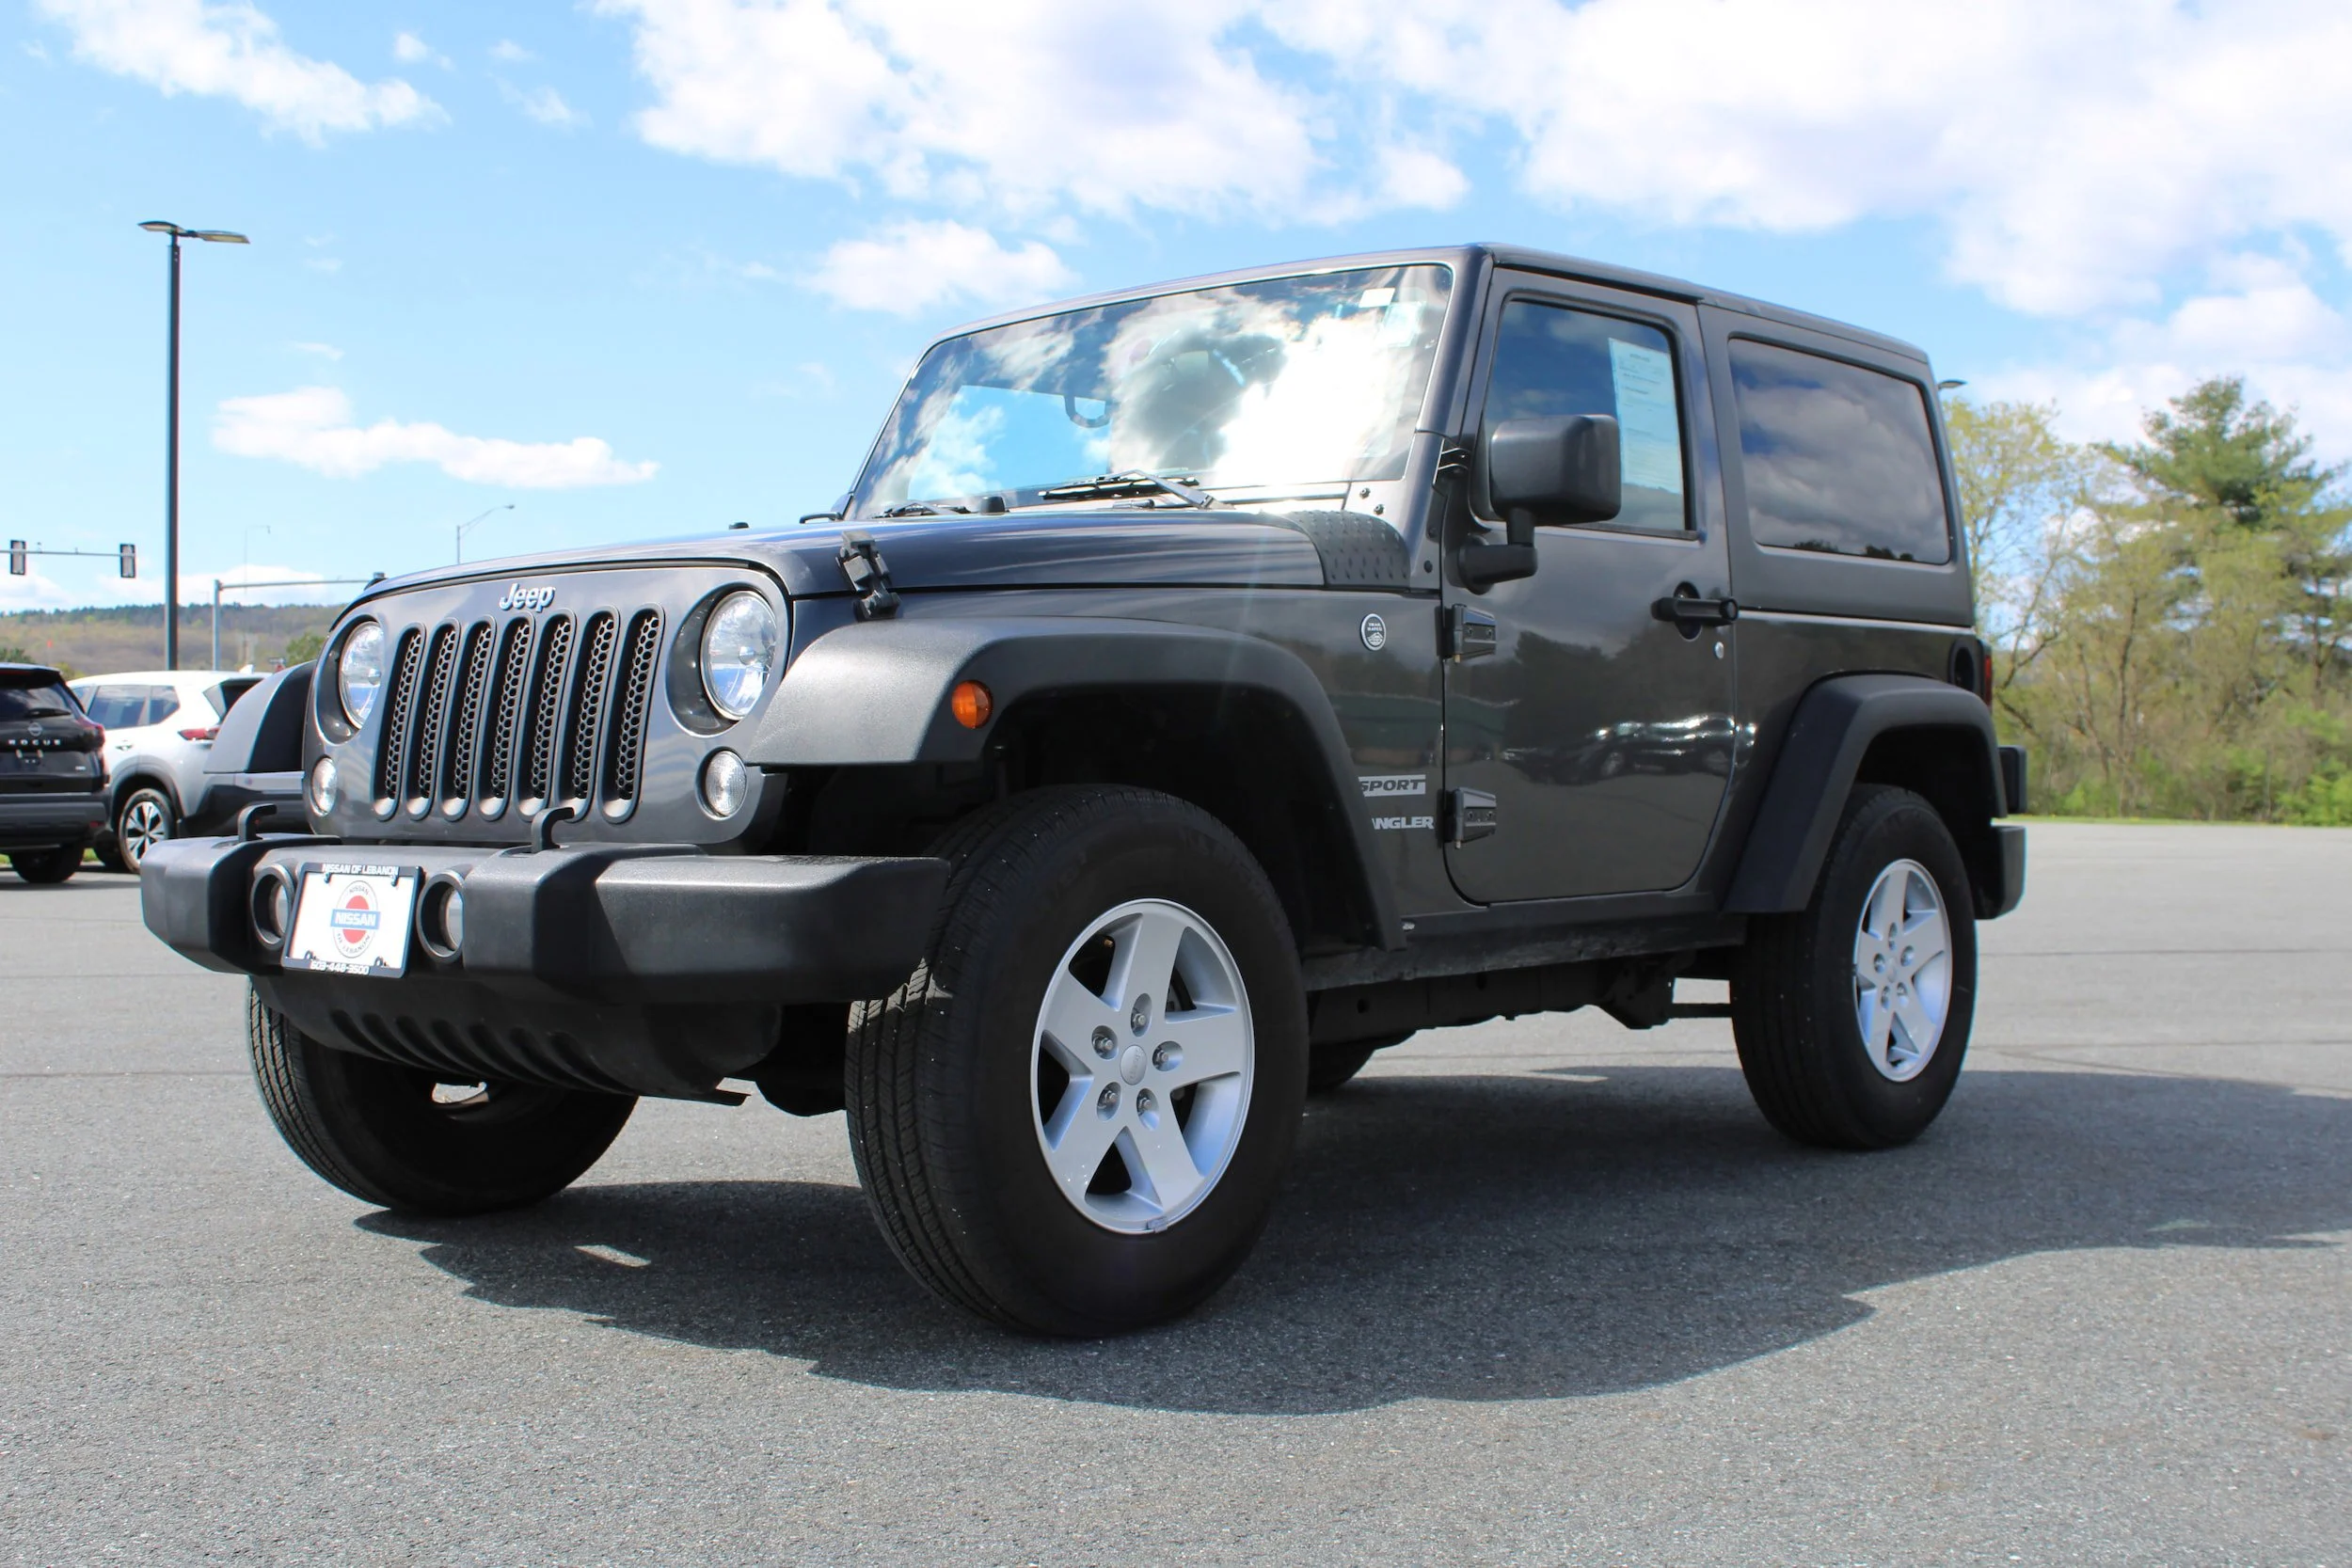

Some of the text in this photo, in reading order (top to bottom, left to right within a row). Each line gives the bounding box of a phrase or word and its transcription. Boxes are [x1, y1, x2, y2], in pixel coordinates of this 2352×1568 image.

[499, 582, 556, 613] Jeep
[1360, 779, 1425, 792] SPORT
[322, 863, 399, 876] NISSAN OF LEBANON
[349, 884, 370, 895] NISSAN
[335, 911, 376, 927] NISSAN
[310, 959, 370, 975] 603-448-3500
